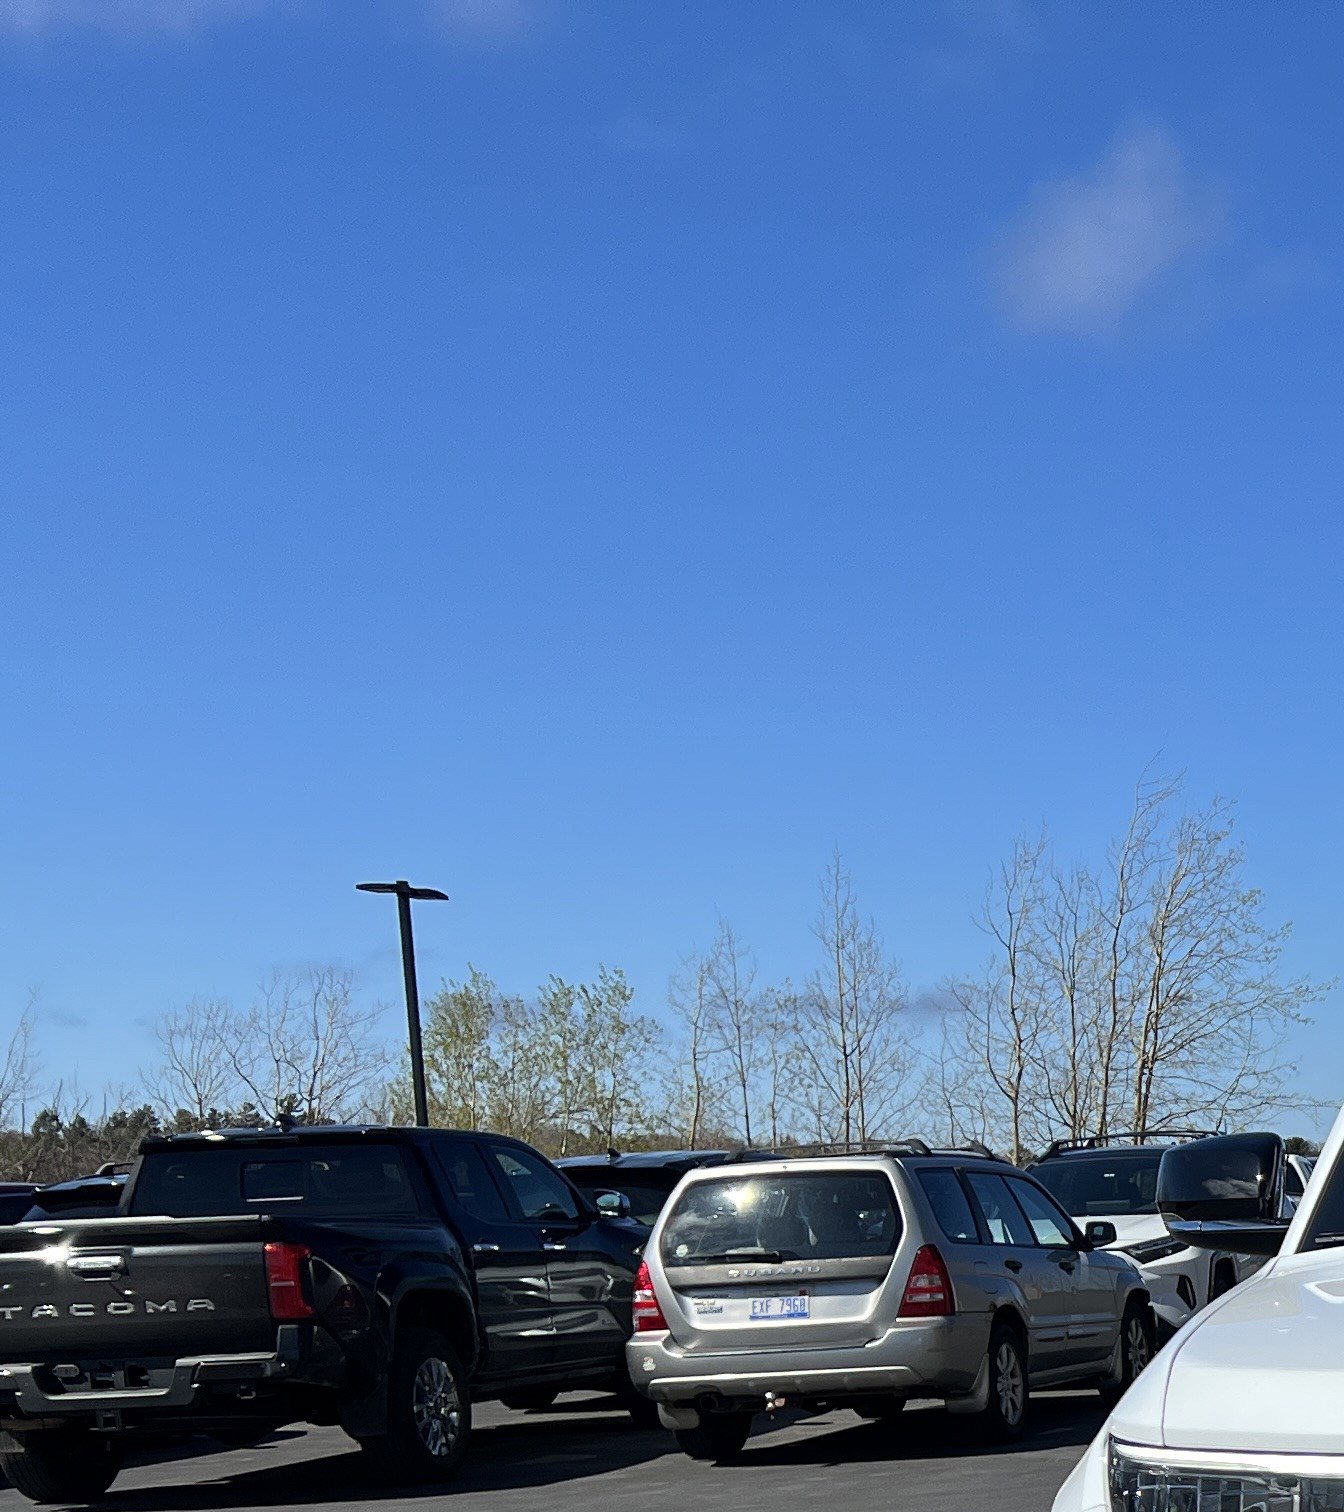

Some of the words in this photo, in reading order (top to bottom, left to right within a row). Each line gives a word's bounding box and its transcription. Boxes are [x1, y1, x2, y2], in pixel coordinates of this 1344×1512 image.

[728, 1265, 821, 1277] SUBARU
[0, 1299, 215, 1320] TACOMA
[752, 1299, 771, 1315] EXF
